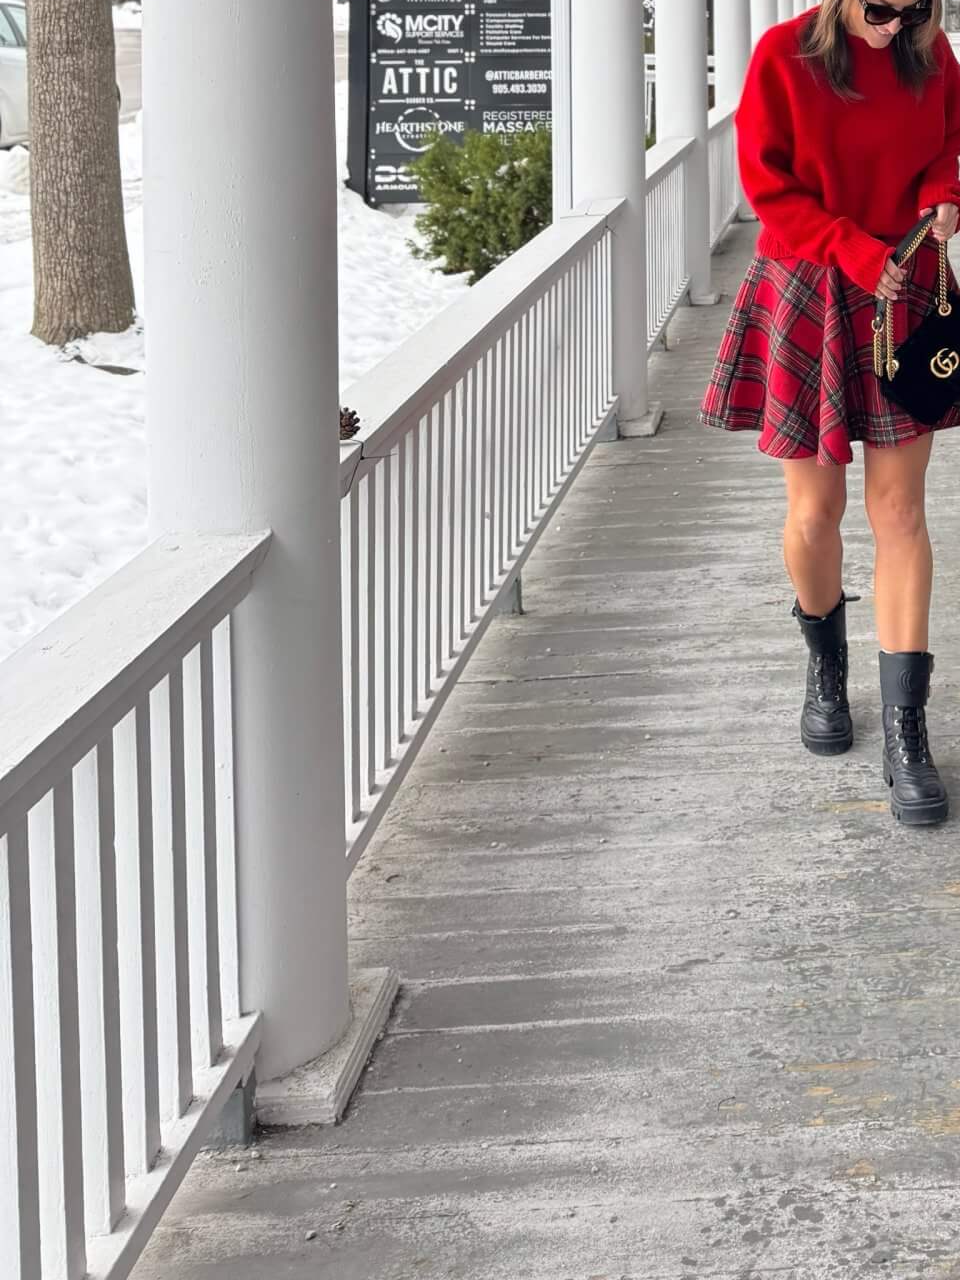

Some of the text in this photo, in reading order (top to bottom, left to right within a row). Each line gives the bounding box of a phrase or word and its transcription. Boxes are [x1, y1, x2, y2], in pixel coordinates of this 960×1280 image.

[405, 14, 464, 32] MCITY
[382, 67, 458, 94] ATTIC
[483, 111, 552, 121] REGISTERED
[375, 120, 465, 135] HEARTHSTONE
[375, 183, 417, 191] ARMOUR
